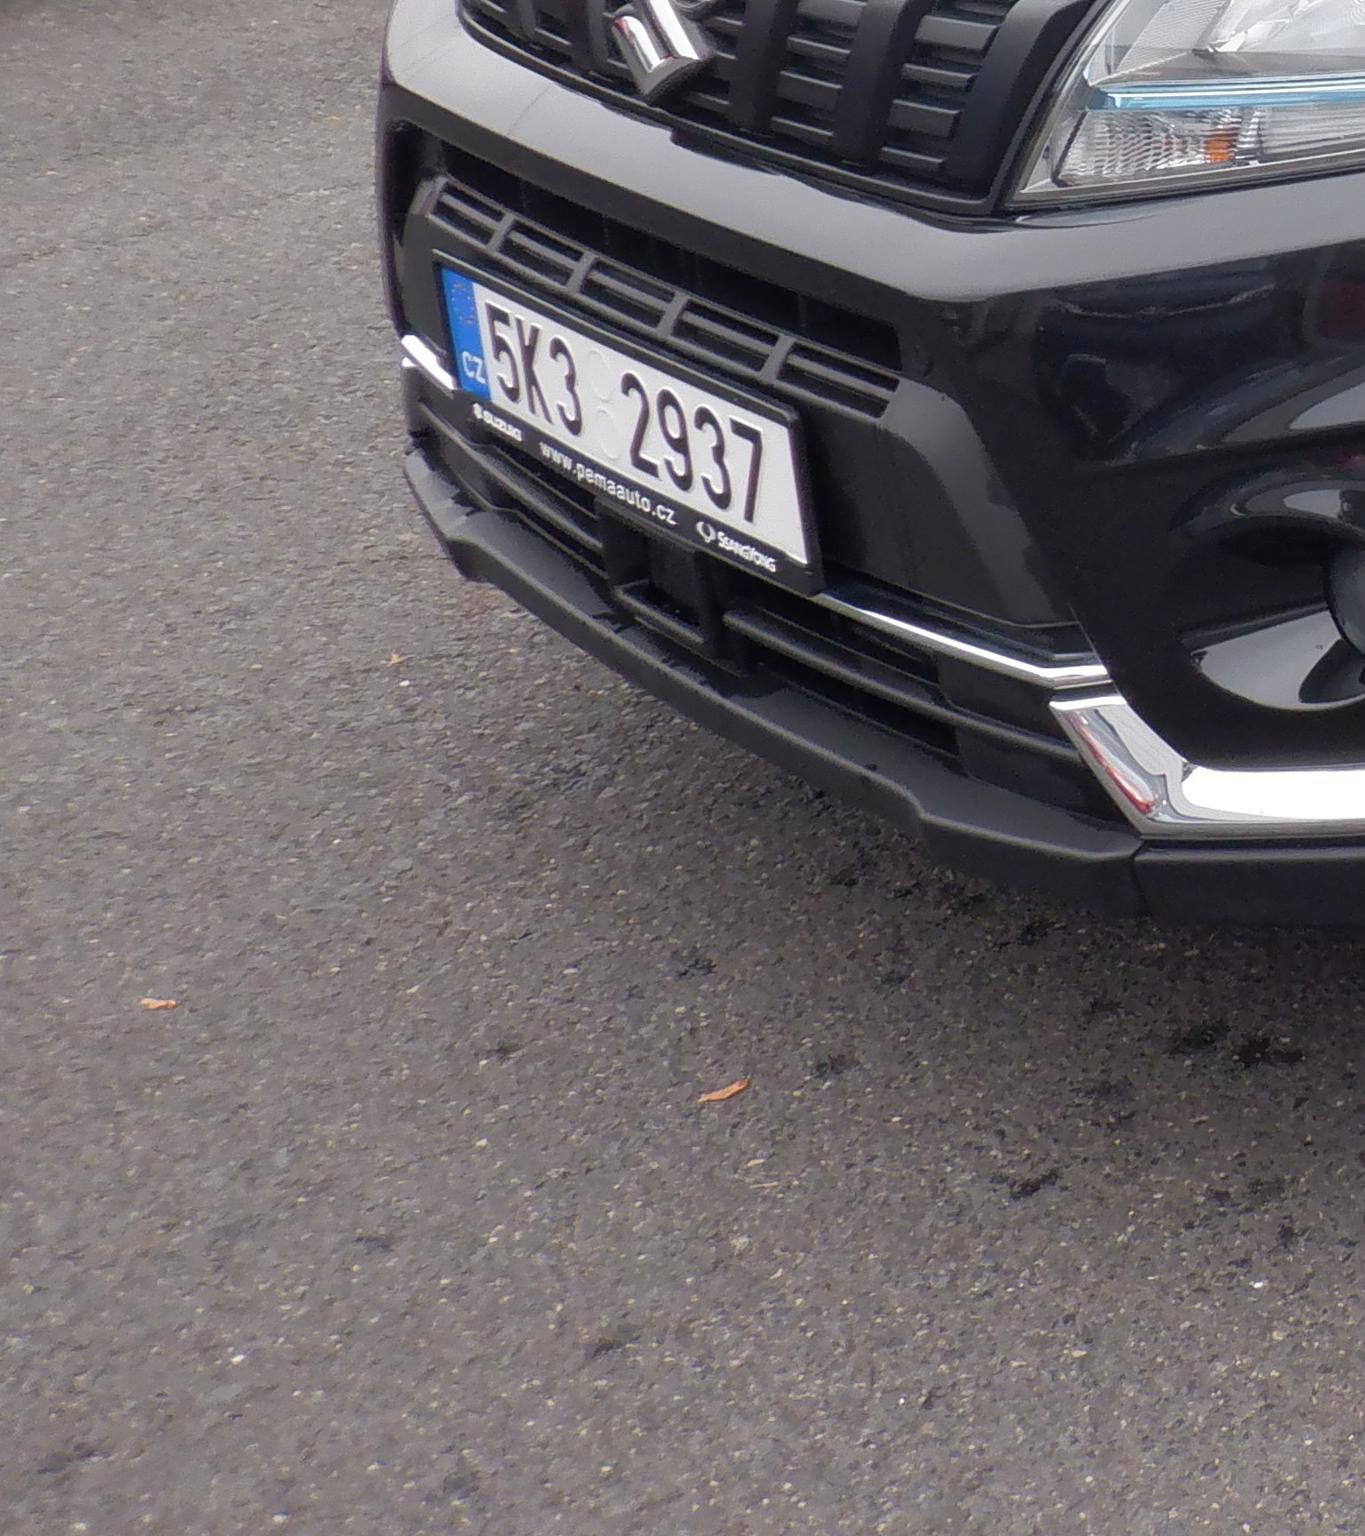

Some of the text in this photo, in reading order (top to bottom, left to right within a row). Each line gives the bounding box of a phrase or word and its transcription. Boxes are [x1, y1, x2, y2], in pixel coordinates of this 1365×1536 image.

[462, 349, 487, 385] CZ
[485, 299, 764, 524] 5K3 2937
[539, 440, 678, 525] www.pemaauto.cz
